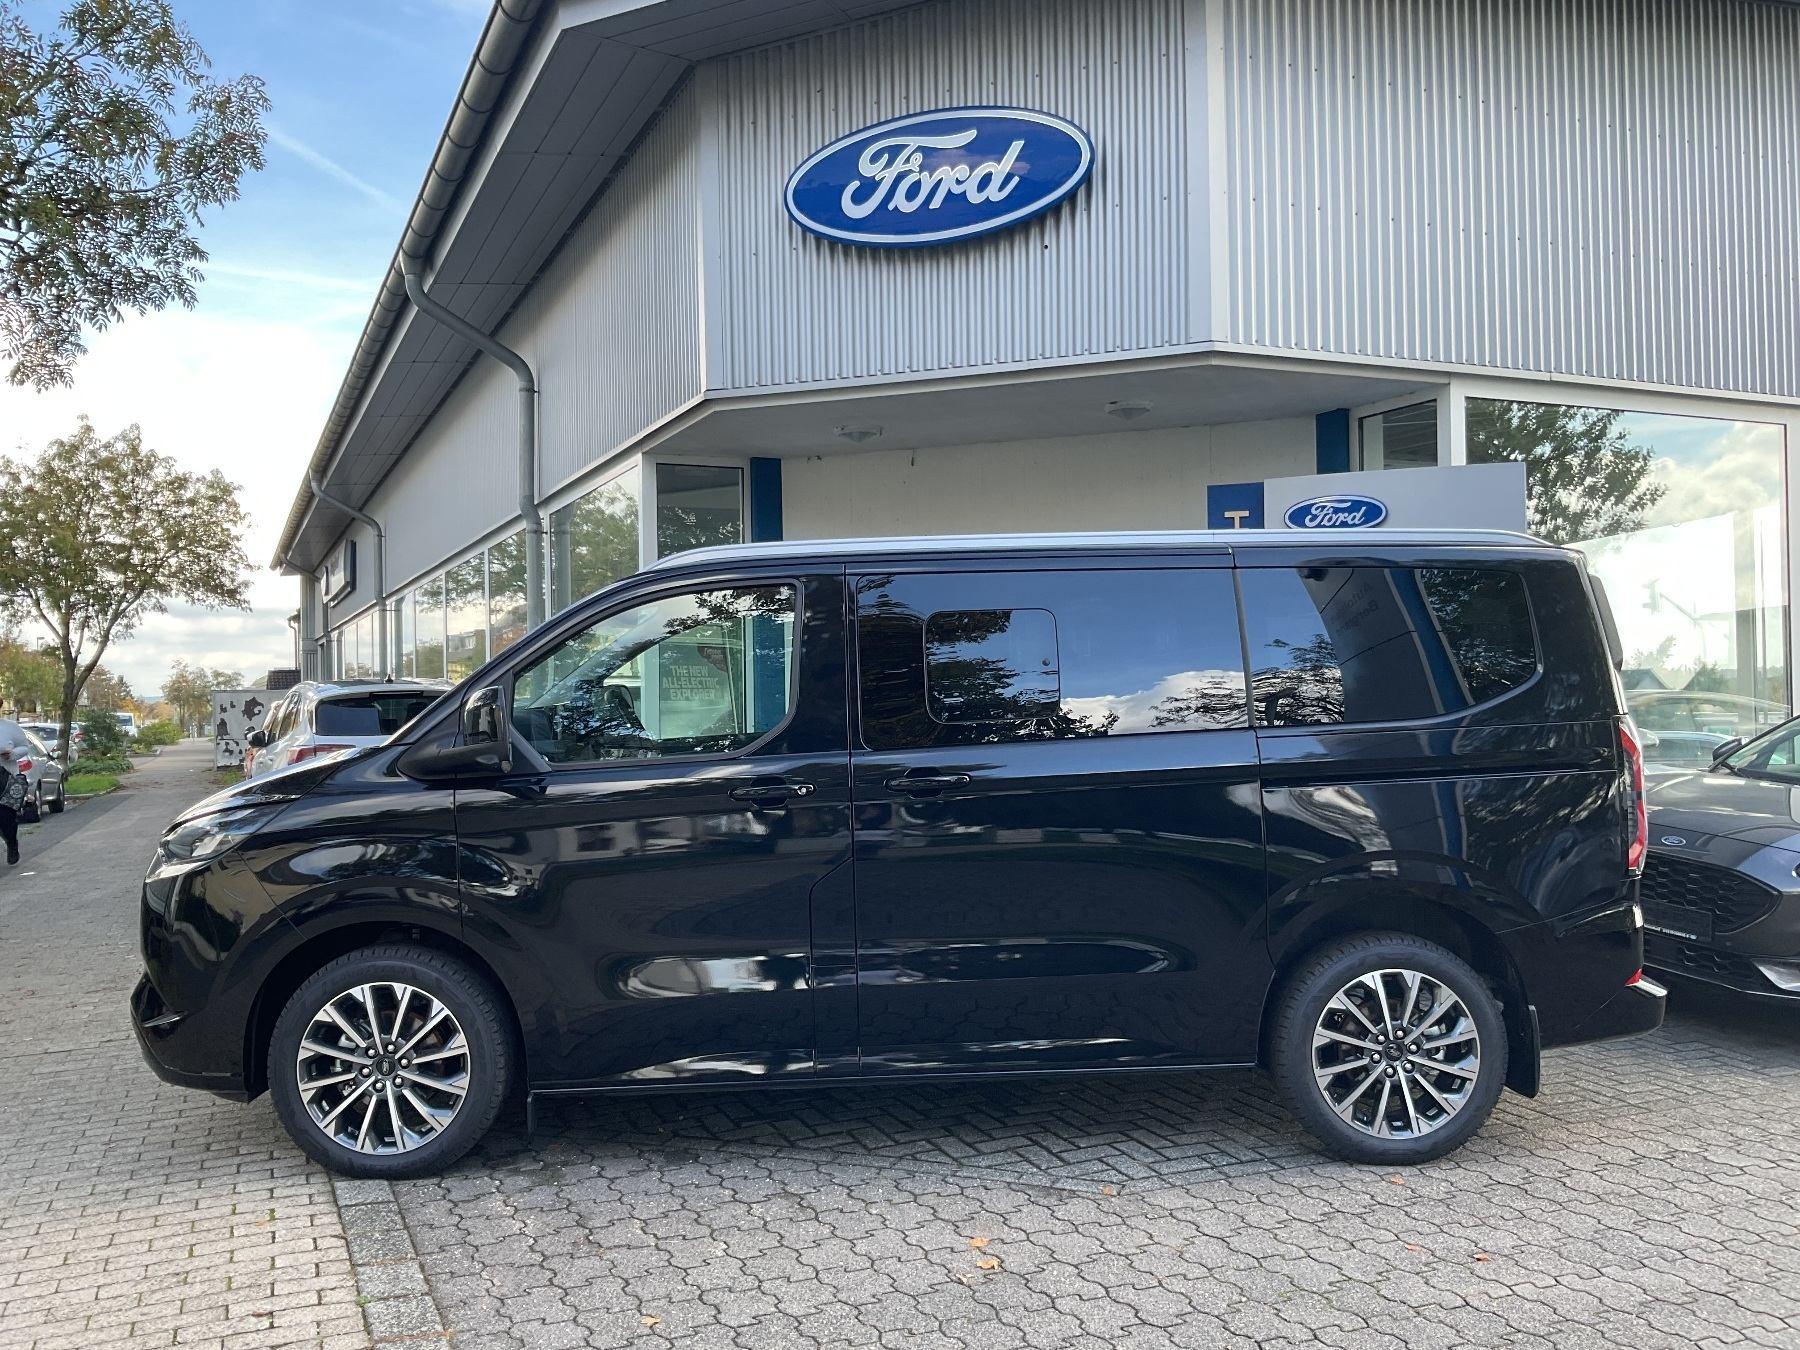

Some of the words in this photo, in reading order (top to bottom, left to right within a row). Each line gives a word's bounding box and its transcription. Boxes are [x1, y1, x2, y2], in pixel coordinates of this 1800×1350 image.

[841, 129, 1025, 219] Ford
[1304, 502, 1367, 528] Ford
[670, 665, 689, 677] THE
[690, 665, 709, 677] NEW
[662, 676, 720, 689] ALL-ELECTRIC
[670, 688, 715, 700] EXPLORER
